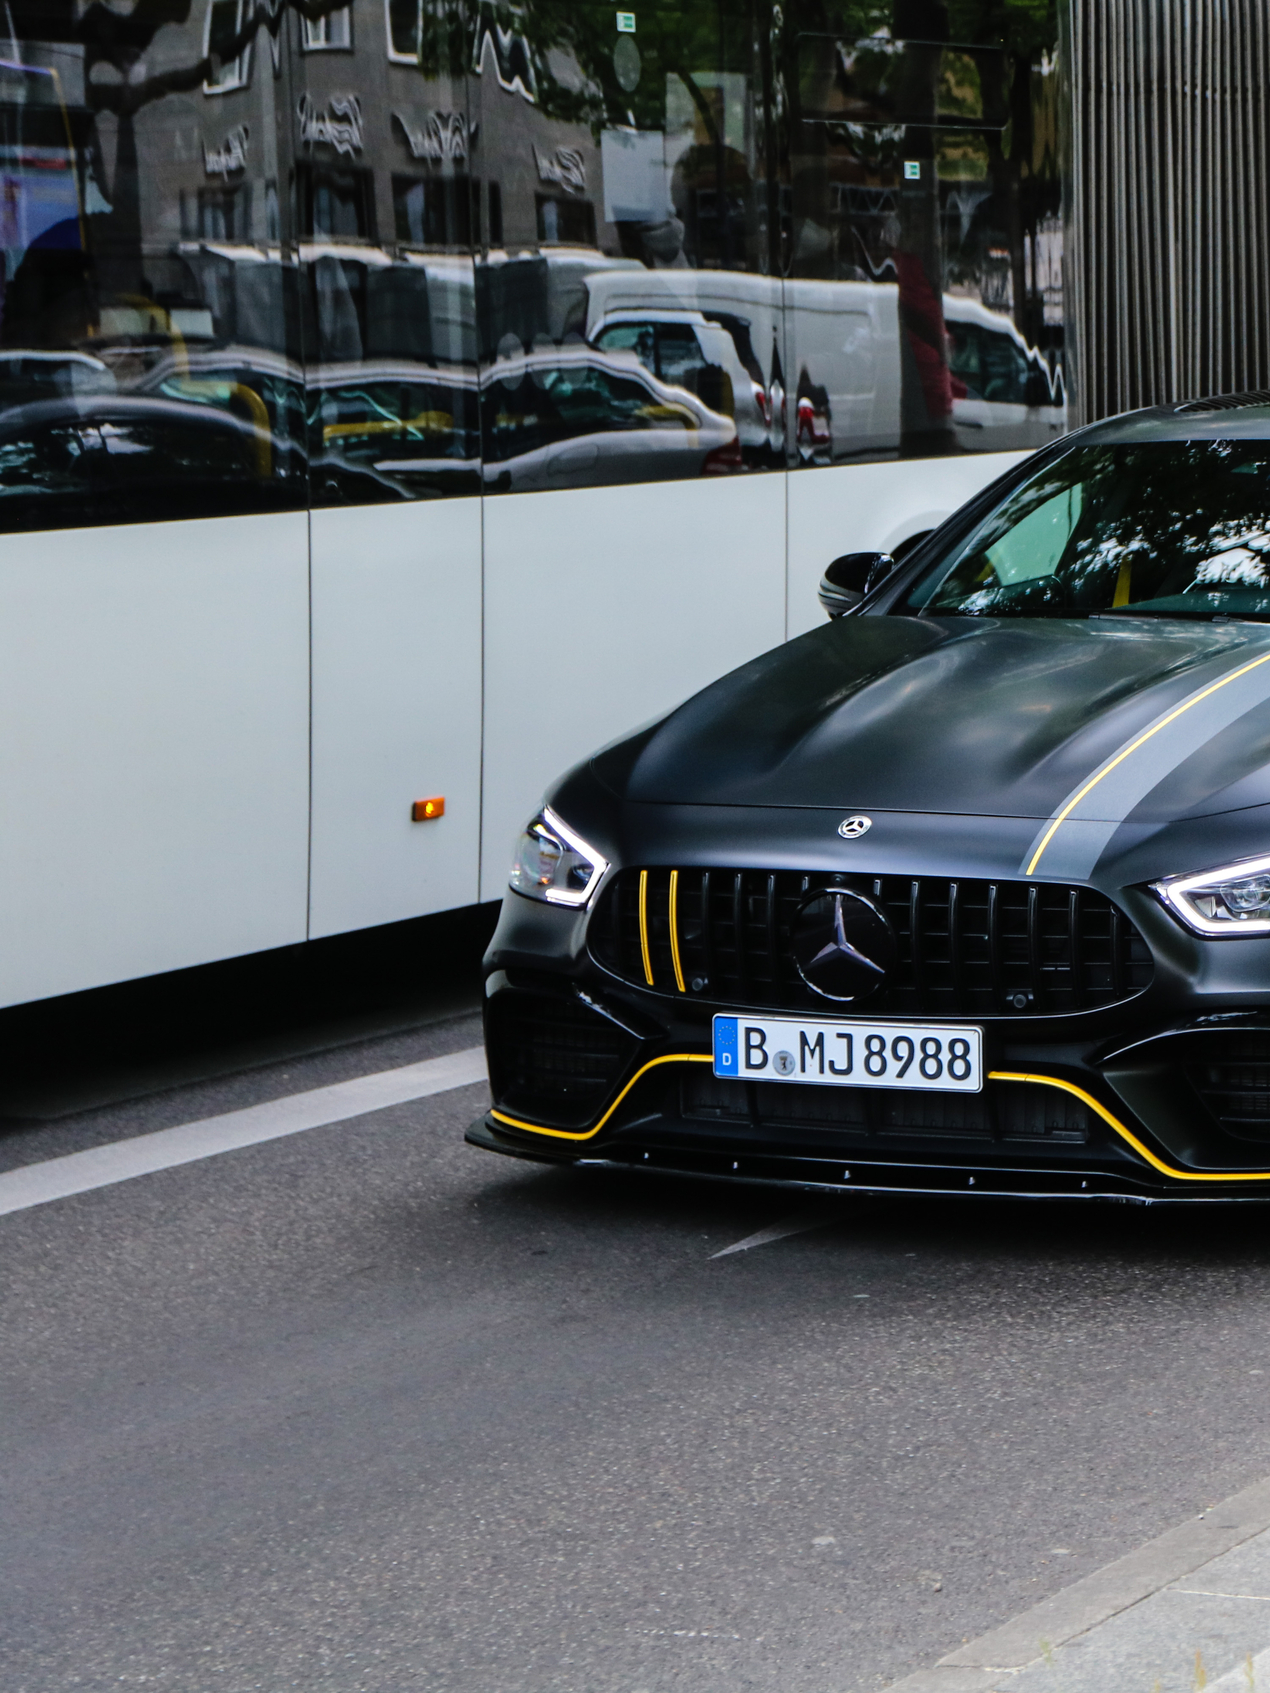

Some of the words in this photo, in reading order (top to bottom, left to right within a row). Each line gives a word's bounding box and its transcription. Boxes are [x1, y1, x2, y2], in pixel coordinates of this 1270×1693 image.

[722, 1052, 732, 1066] D
[744, 1026, 769, 1070] B
[799, 1030, 854, 1076] MJ
[863, 1033, 973, 1081] 8988
